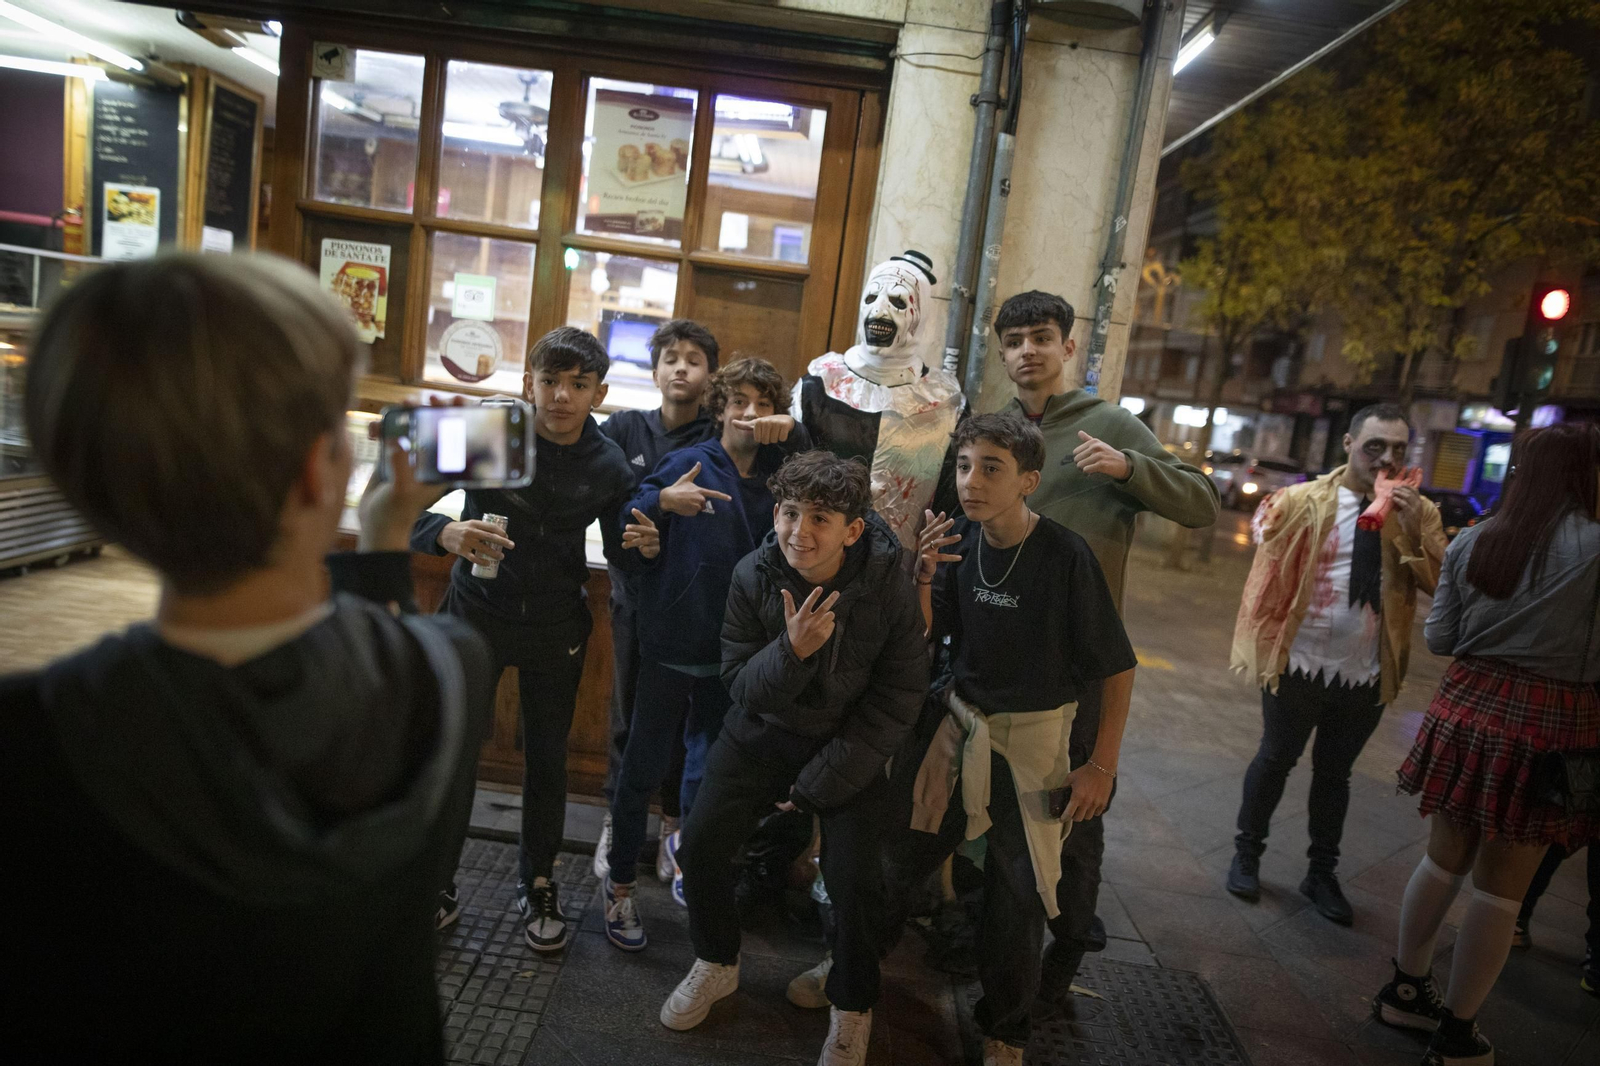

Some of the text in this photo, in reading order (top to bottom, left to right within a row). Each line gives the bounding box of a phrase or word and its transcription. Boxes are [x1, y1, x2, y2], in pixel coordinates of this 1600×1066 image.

[331, 242, 383, 255] PIONONOS
[324, 249, 386, 263] DE SANTA FE
